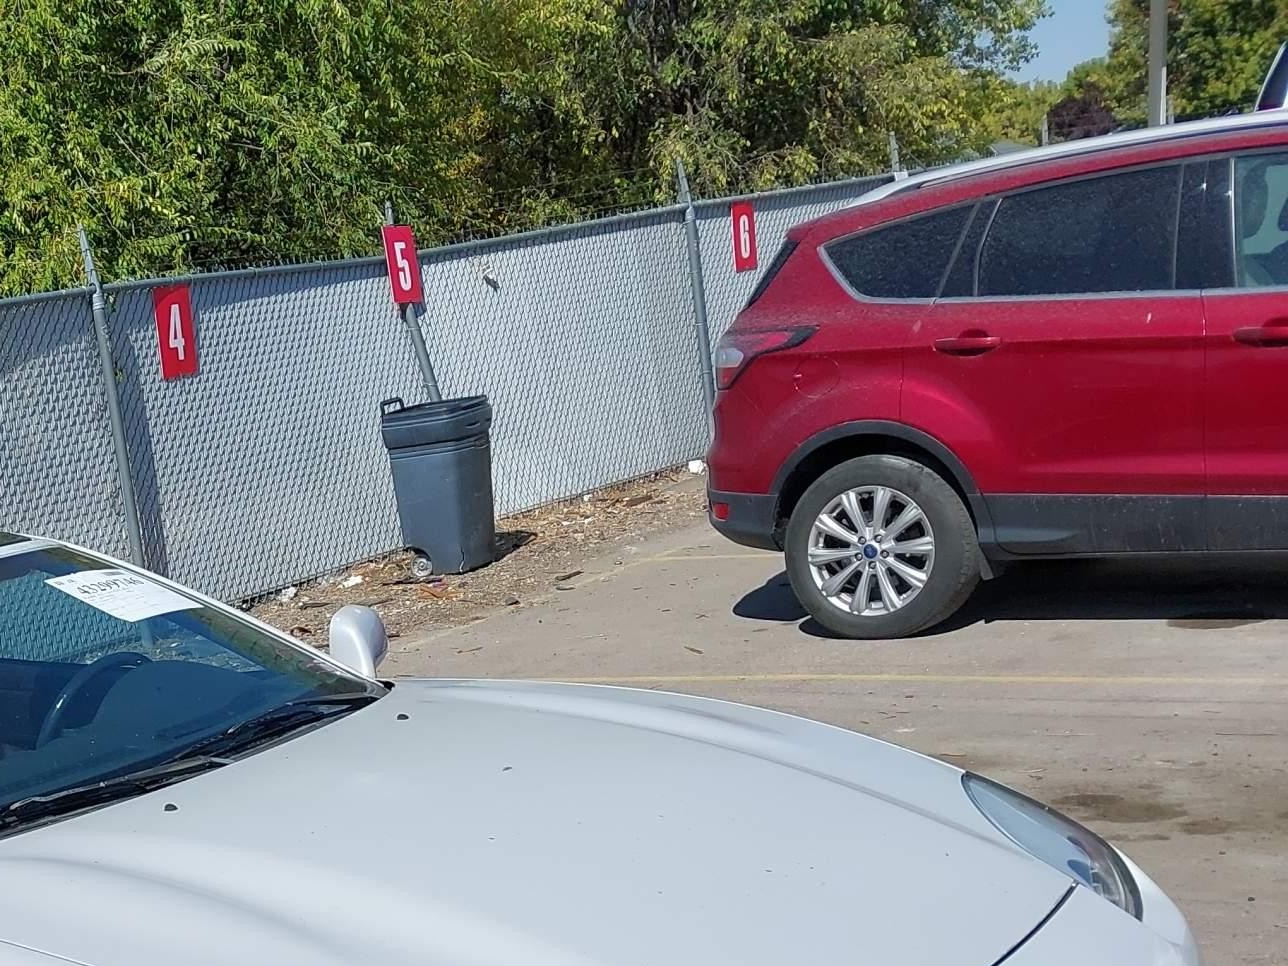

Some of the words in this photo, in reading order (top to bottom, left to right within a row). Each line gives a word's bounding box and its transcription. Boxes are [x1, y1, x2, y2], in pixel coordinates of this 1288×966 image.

[739, 214, 751, 259] 6
[393, 241, 412, 292] 5
[168, 303, 185, 361] 4
[76, 576, 145, 594] 43299746
